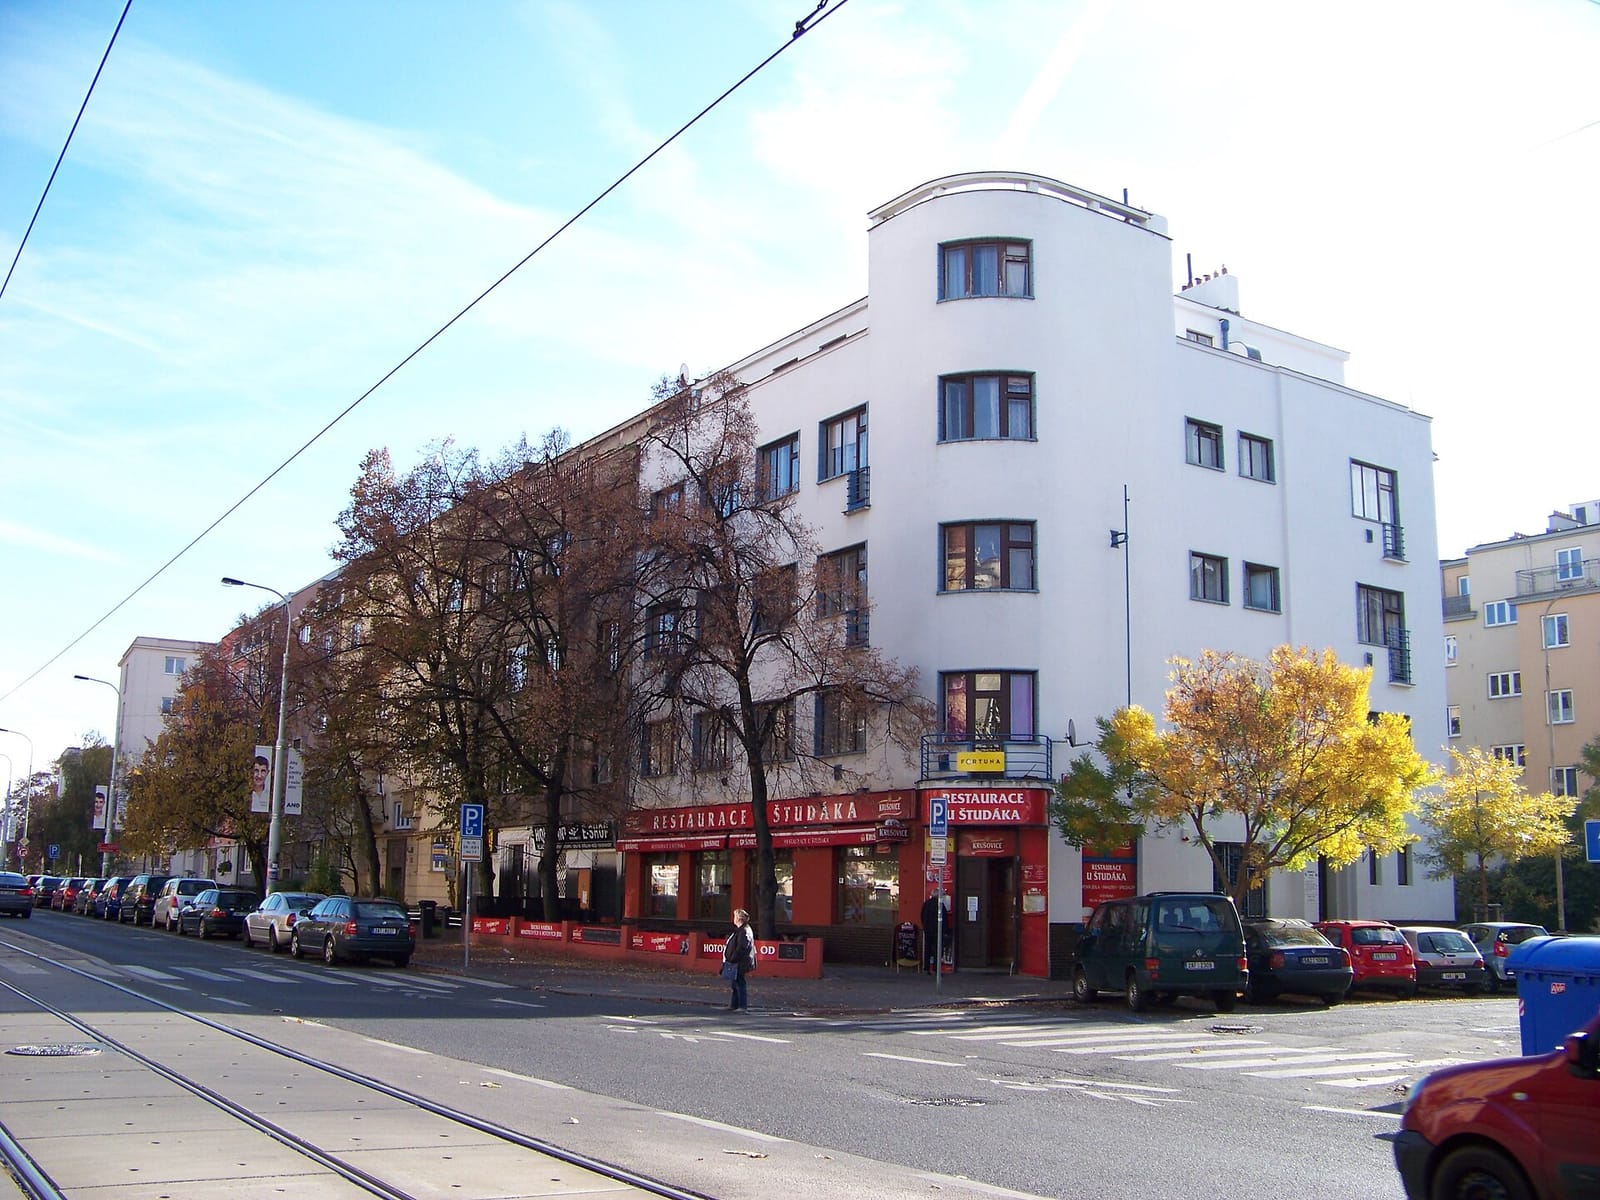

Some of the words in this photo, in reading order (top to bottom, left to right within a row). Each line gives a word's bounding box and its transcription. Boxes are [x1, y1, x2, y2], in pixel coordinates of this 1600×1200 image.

[942, 793, 1025, 804] RESTAURACE
[879, 802, 901, 811] KRUŠOVICE
[652, 809, 748, 830] RESTAURACE
[772, 801, 858, 823] ŠTUDÁKA
[959, 807, 1020, 820] ŠTUDÁKA
[972, 841, 1003, 850] KRUŠOVICE
[1091, 863, 1122, 871] RESTAURACE
[1086, 873, 1092, 881] U
[1093, 871, 1127, 881] ŠTUDÁKA
[760, 945, 775, 955] OD
